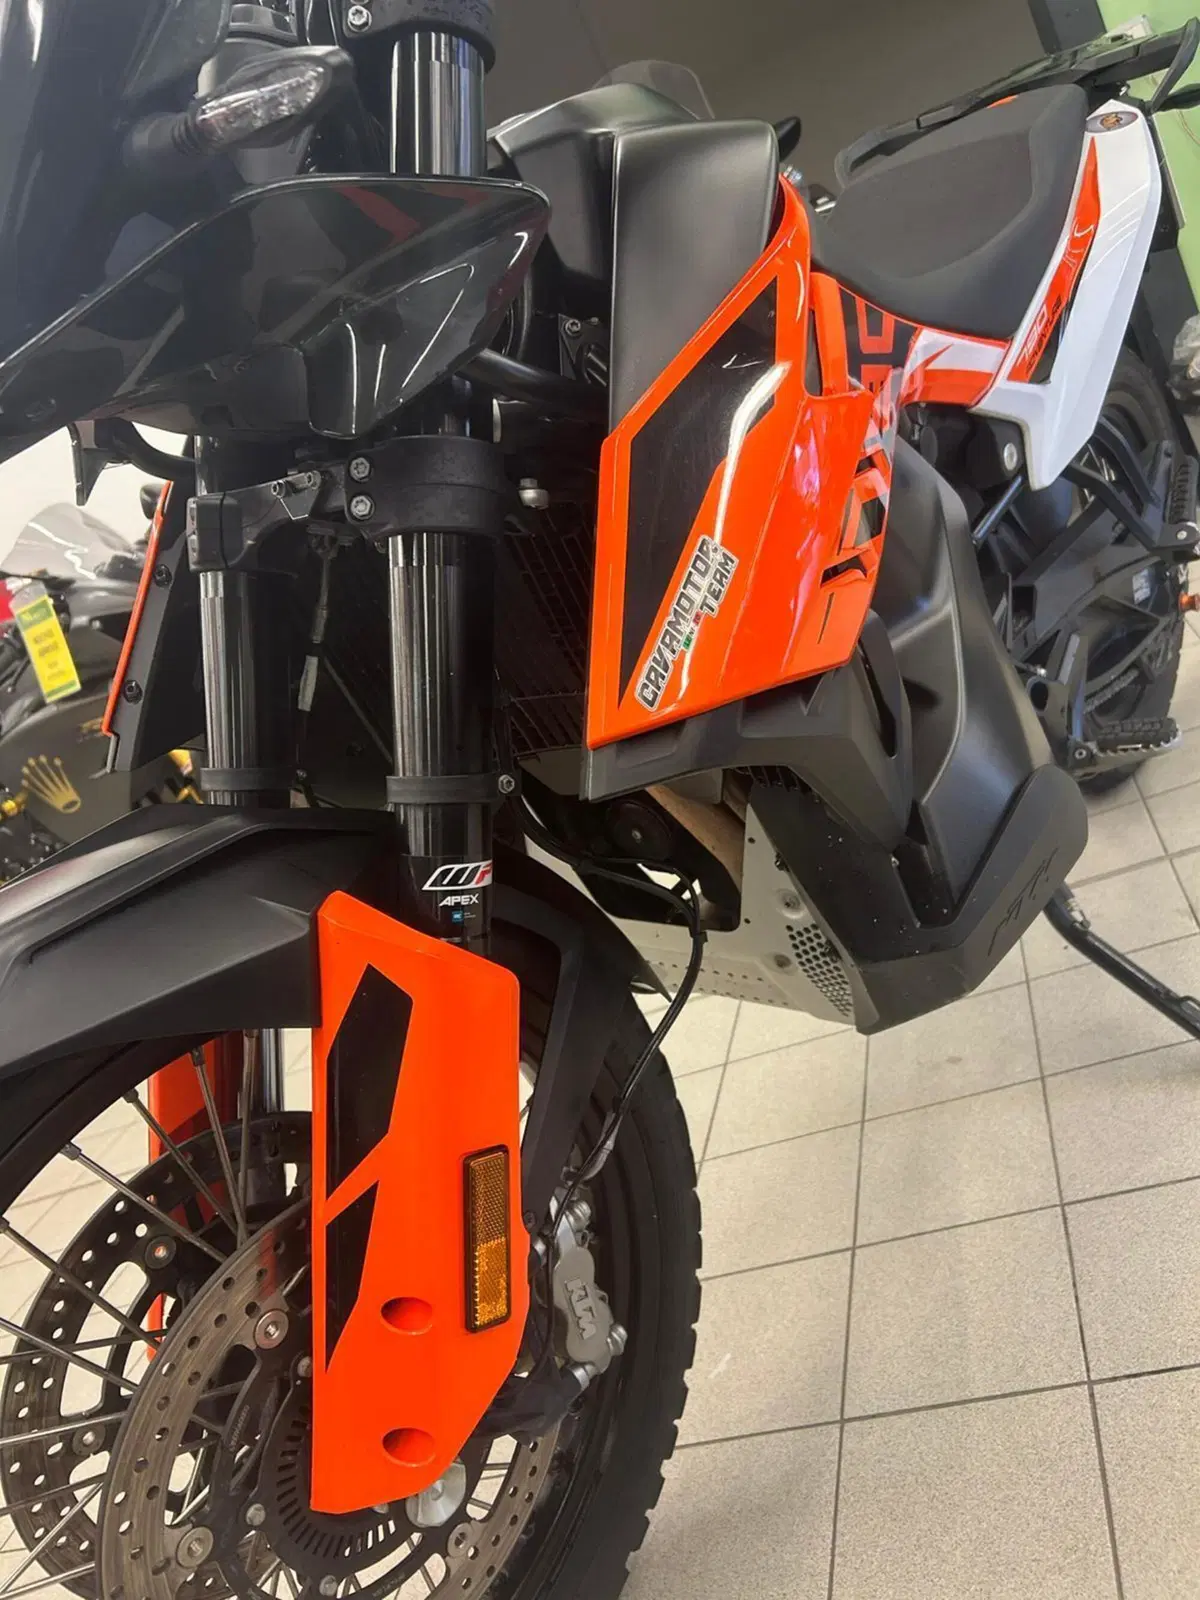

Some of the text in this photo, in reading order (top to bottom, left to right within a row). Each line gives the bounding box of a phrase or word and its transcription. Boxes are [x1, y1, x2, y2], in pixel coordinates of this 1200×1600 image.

[699, 551, 736, 613] TEAM
[637, 537, 715, 709] CAVAMOTOR
[438, 893, 480, 907] APEX
[564, 1278, 597, 1341] KTM
